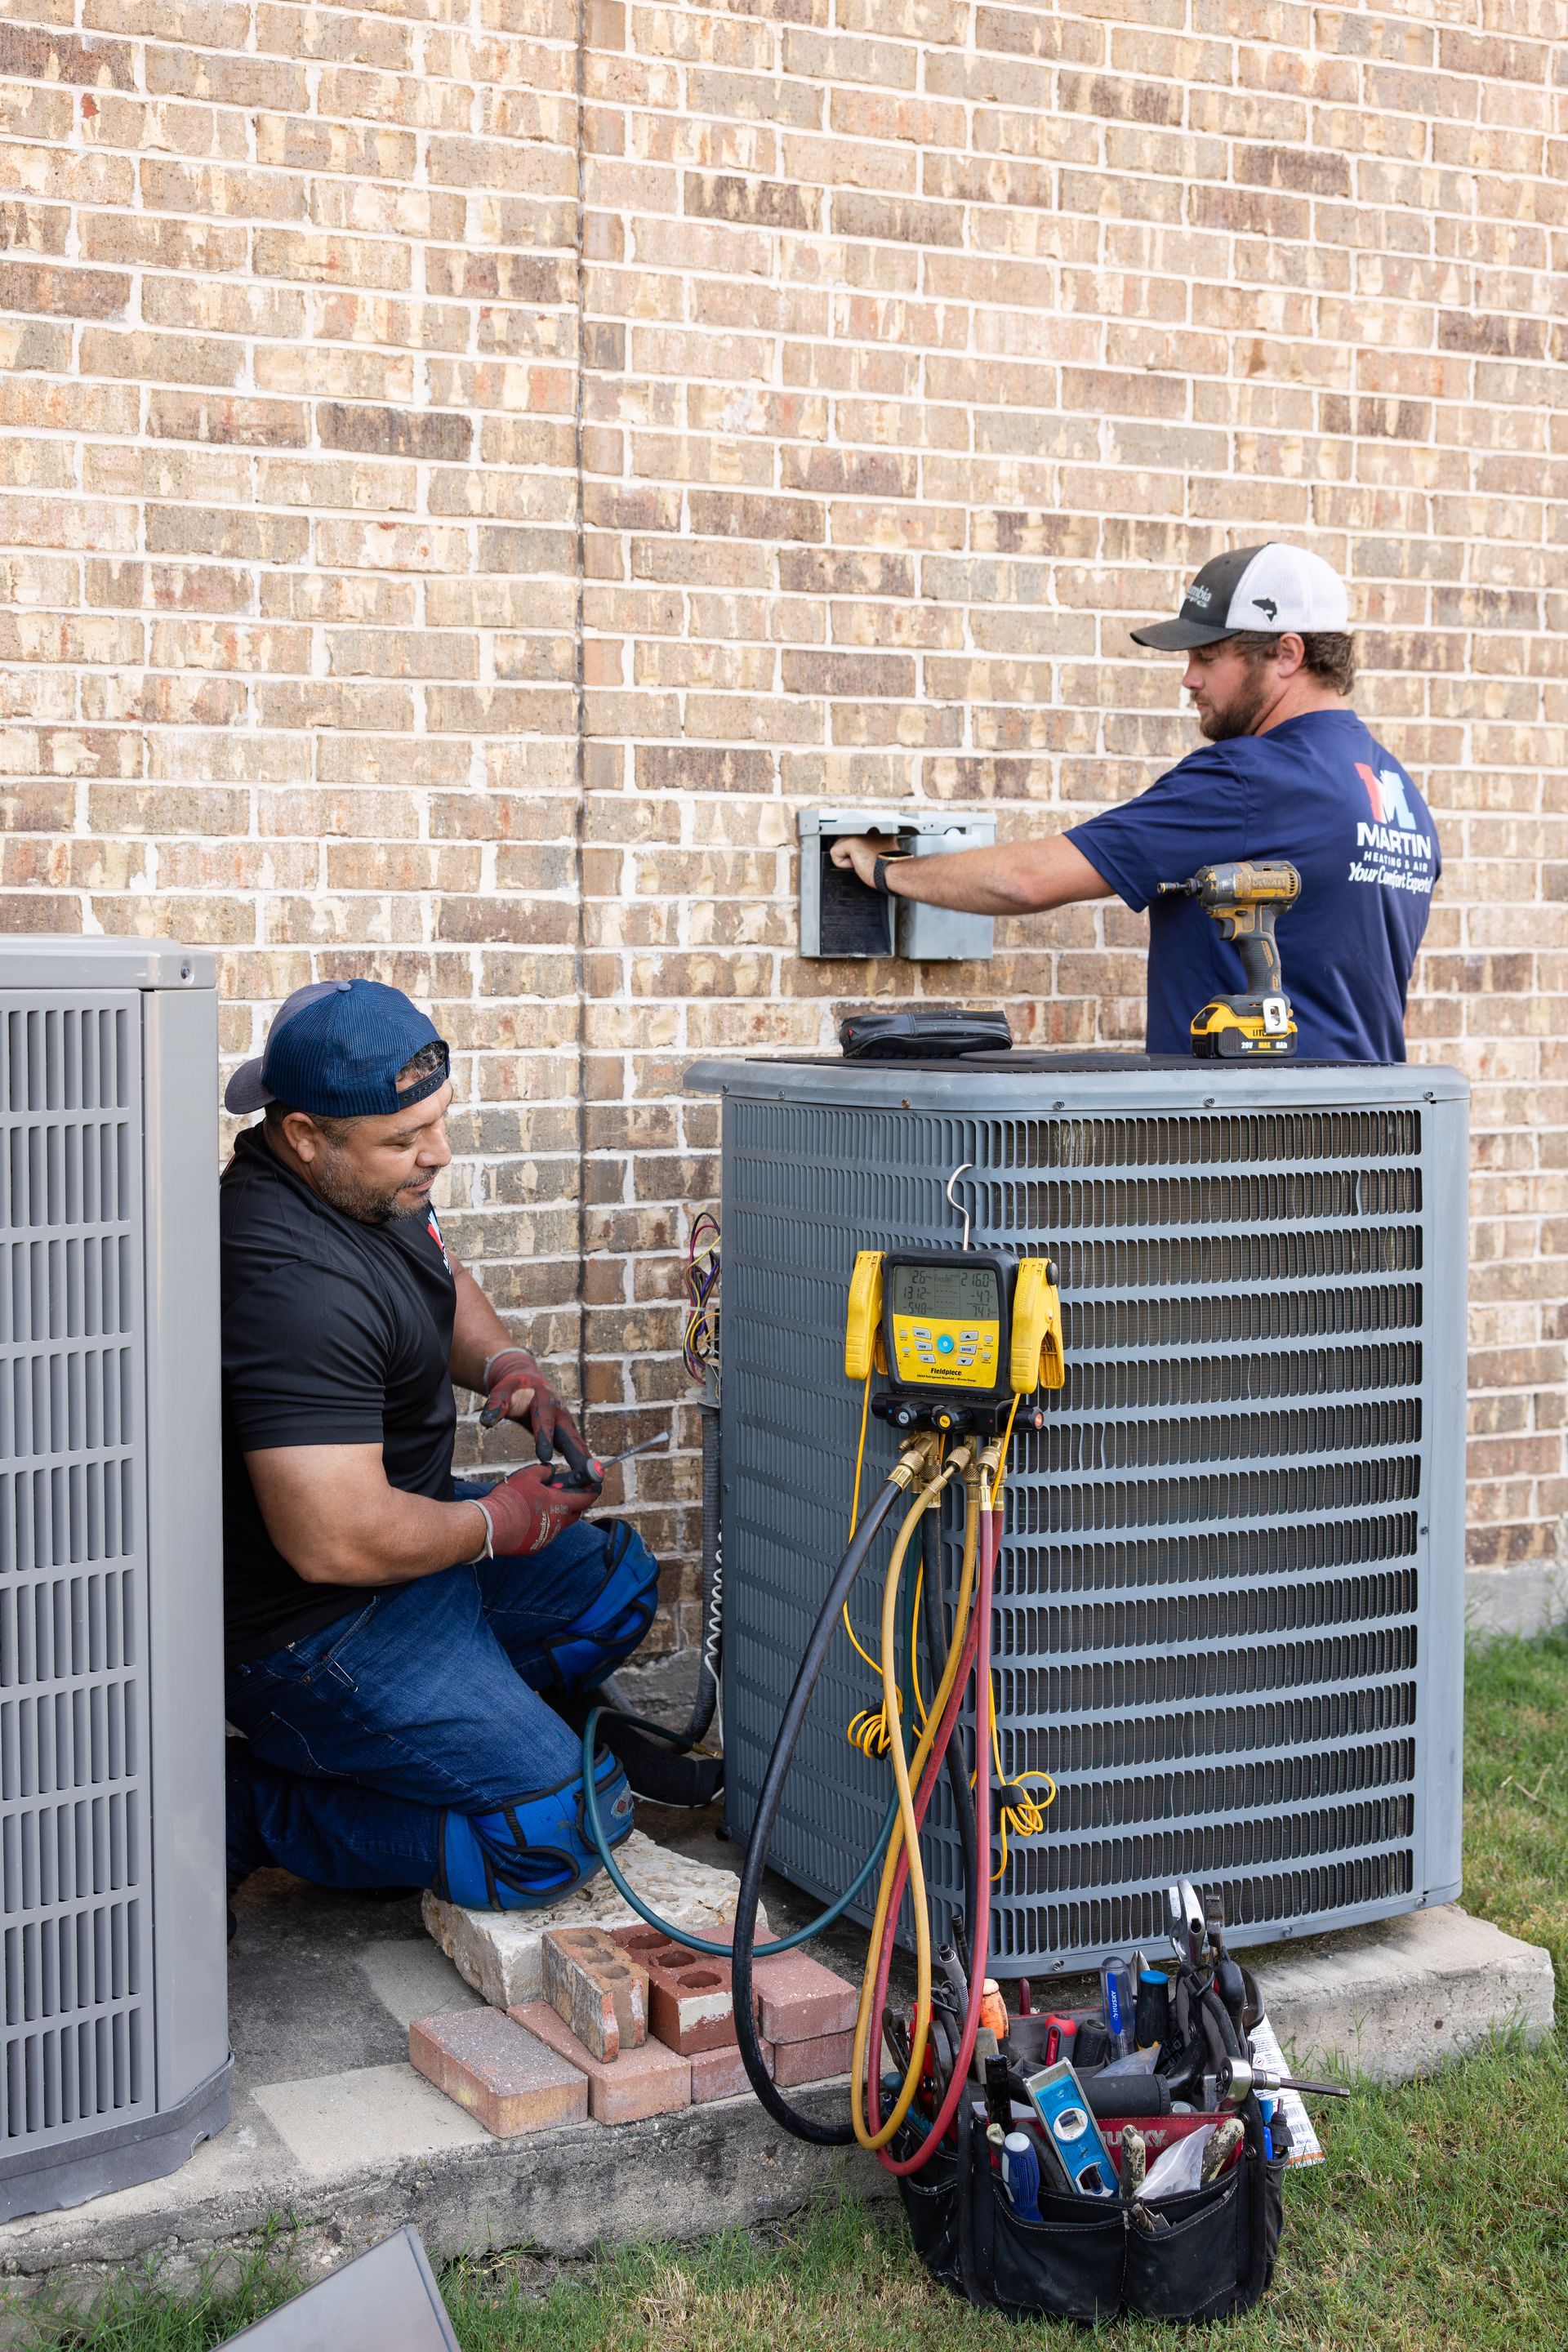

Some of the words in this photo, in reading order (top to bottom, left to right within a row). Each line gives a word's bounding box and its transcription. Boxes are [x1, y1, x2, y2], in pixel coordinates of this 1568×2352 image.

[1357, 822, 1432, 859] MARTIN
[1364, 851, 1401, 868] HEATING
[1405, 860, 1410, 870] &
[1413, 862, 1428, 872] AIR
[1348, 862, 1378, 882] Your
[1378, 866, 1406, 889] Comfort
[930, 1367, 962, 1376] Fieldpiece
[1102, 2130, 1167, 2147] UKY
